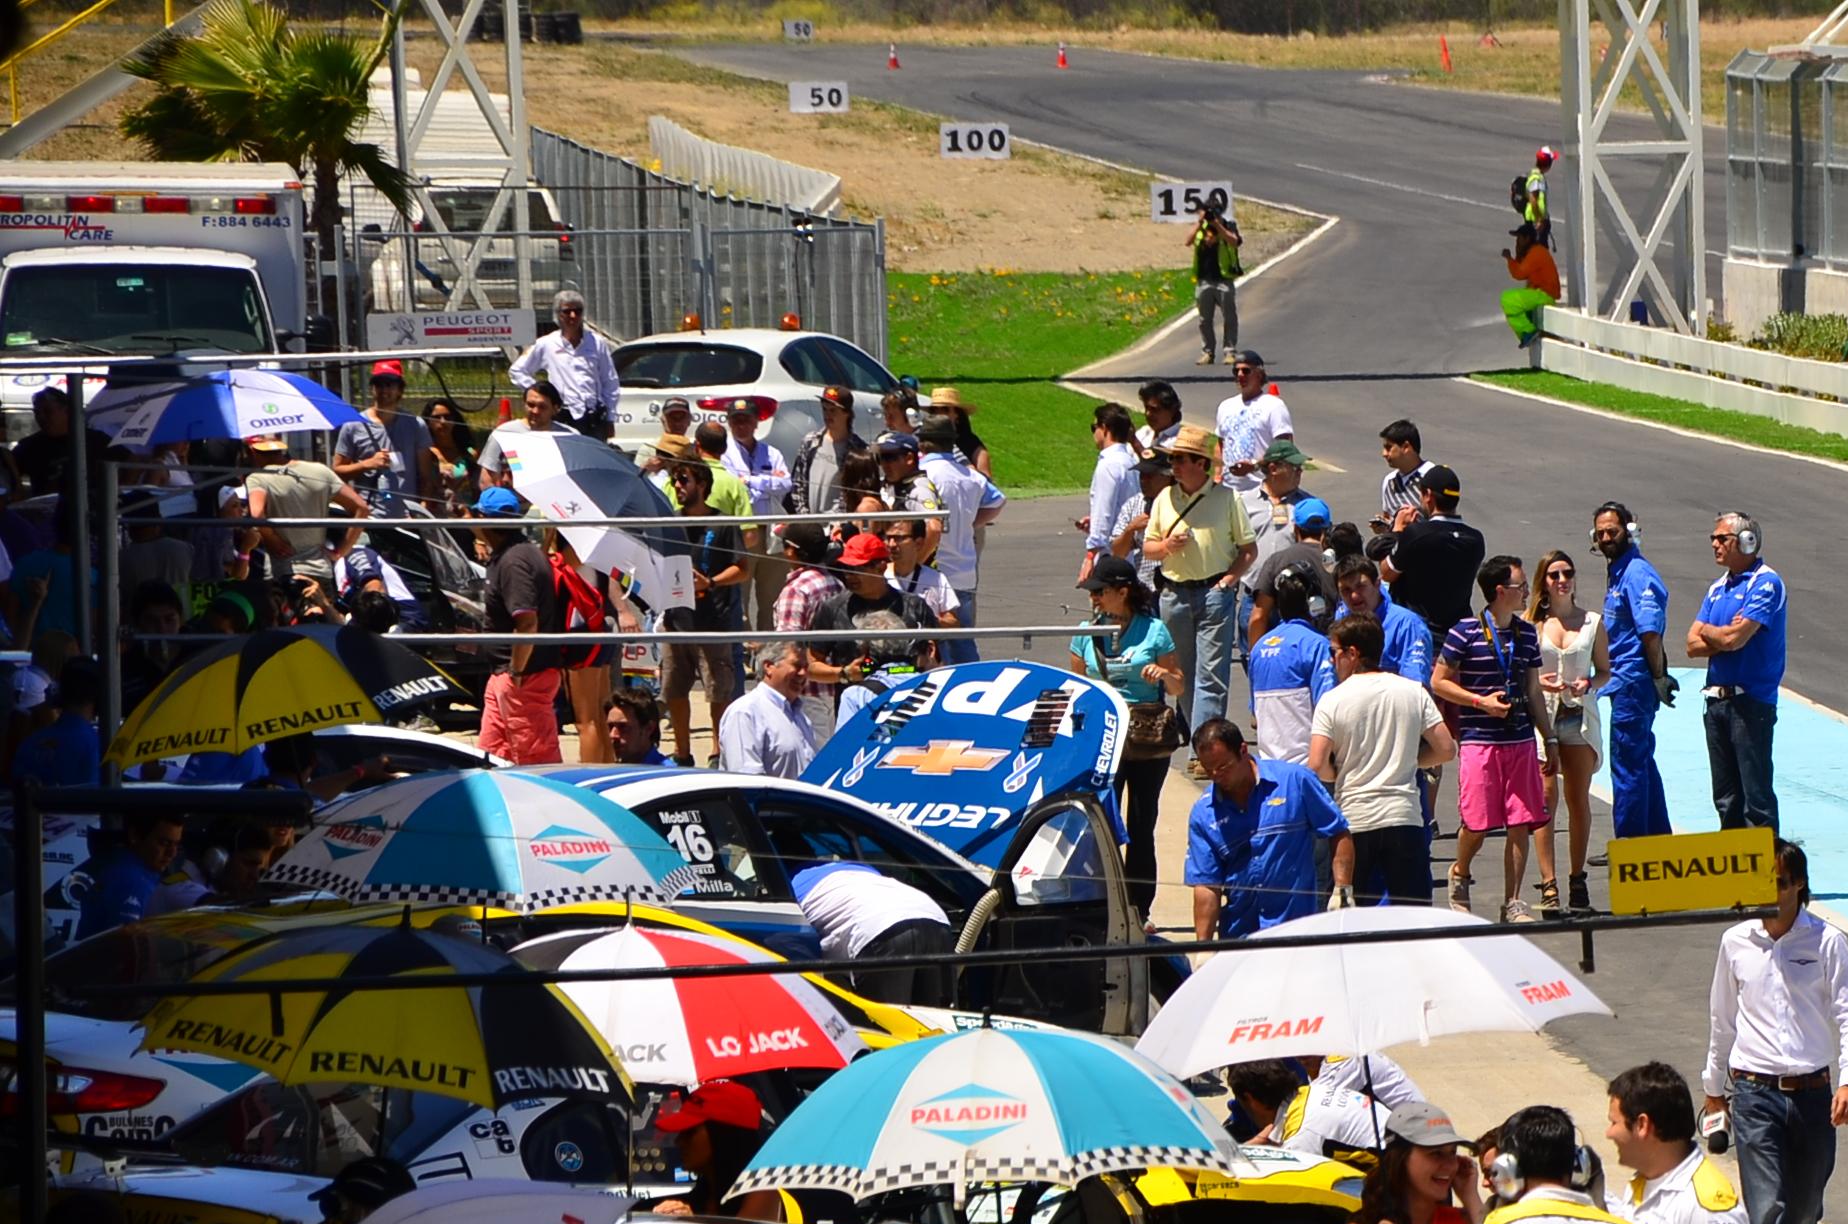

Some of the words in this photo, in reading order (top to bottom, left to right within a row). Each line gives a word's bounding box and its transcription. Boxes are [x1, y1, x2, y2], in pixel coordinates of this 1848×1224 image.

[793, 24, 812, 38] 50
[810, 87, 842, 108] 50
[946, 129, 1006, 153] 100
[1157, 188, 1229, 216] 150
[69, 229, 114, 241] CARE
[202, 217, 247, 228] F:884
[252, 217, 291, 228] 6443
[423, 314, 512, 327] PEUGEOT
[466, 326, 513, 336] SPORT
[250, 413, 304, 429] omer
[373, 674, 449, 711] RENAULT
[246, 701, 363, 740] RENAULT
[134, 727, 231, 758] RENAULT
[1090, 713, 1118, 787] CHEVROLET
[658, 811, 690, 825] Mobil
[322, 824, 383, 849] PALADINI
[529, 840, 613, 857] PALADINI
[666, 824, 714, 863] 16
[1618, 853, 1764, 883] RENAULT
[1520, 980, 1573, 1015] FRAM
[167, 1018, 293, 1066] RENAULT
[1228, 1016, 1325, 1045] FRAM
[310, 1051, 477, 1089] RENAULT
[496, 1064, 611, 1095] RENAULT
[910, 1103, 1029, 1125] PALADINI
